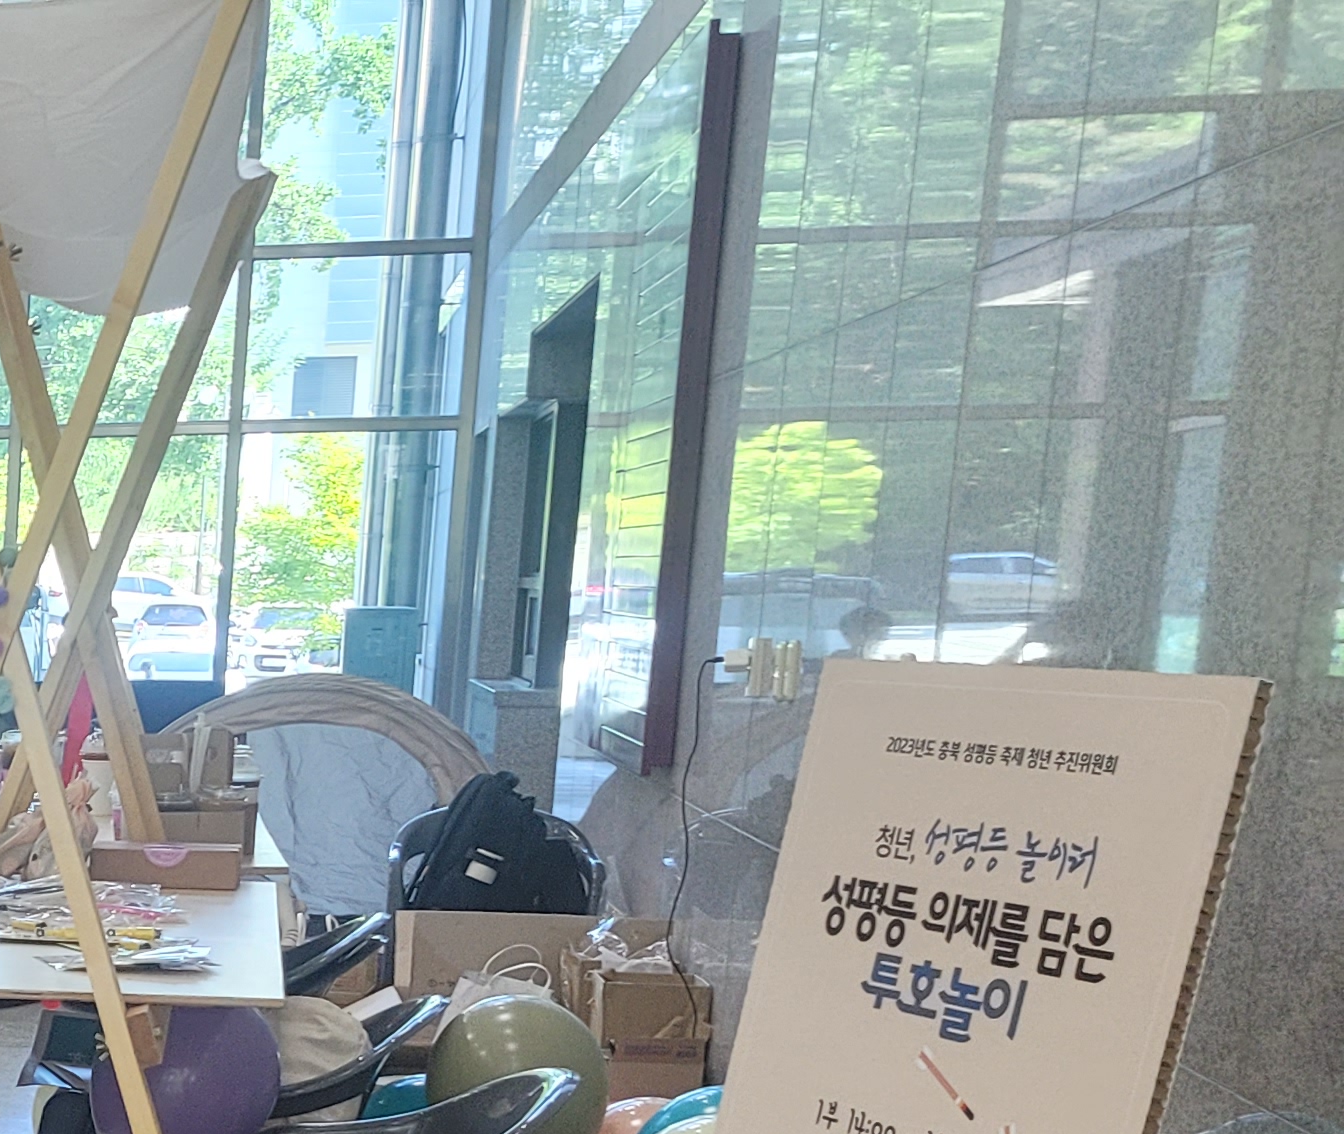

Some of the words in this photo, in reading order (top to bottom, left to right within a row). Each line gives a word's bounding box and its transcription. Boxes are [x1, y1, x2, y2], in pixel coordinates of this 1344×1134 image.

[886, 736, 936, 761] 2023년도
[937, 742, 962, 765] 충북
[963, 743, 998, 766] 성평등
[1000, 746, 1024, 769] 축제
[1028, 747, 1052, 771] 청년
[1053, 749, 1118, 776] 추진위원회
[875, 825, 916, 864] 청년,
[924, 819, 1009, 873] 성평등
[1016, 830, 1099, 889] 놀이터
[821, 874, 918, 945] 성평등
[921, 889, 1029, 968] 의제를
[1034, 910, 1115, 984] 담은
[860, 952, 1029, 1043] 투호놀이
[815, 1099, 839, 1131] 1부
